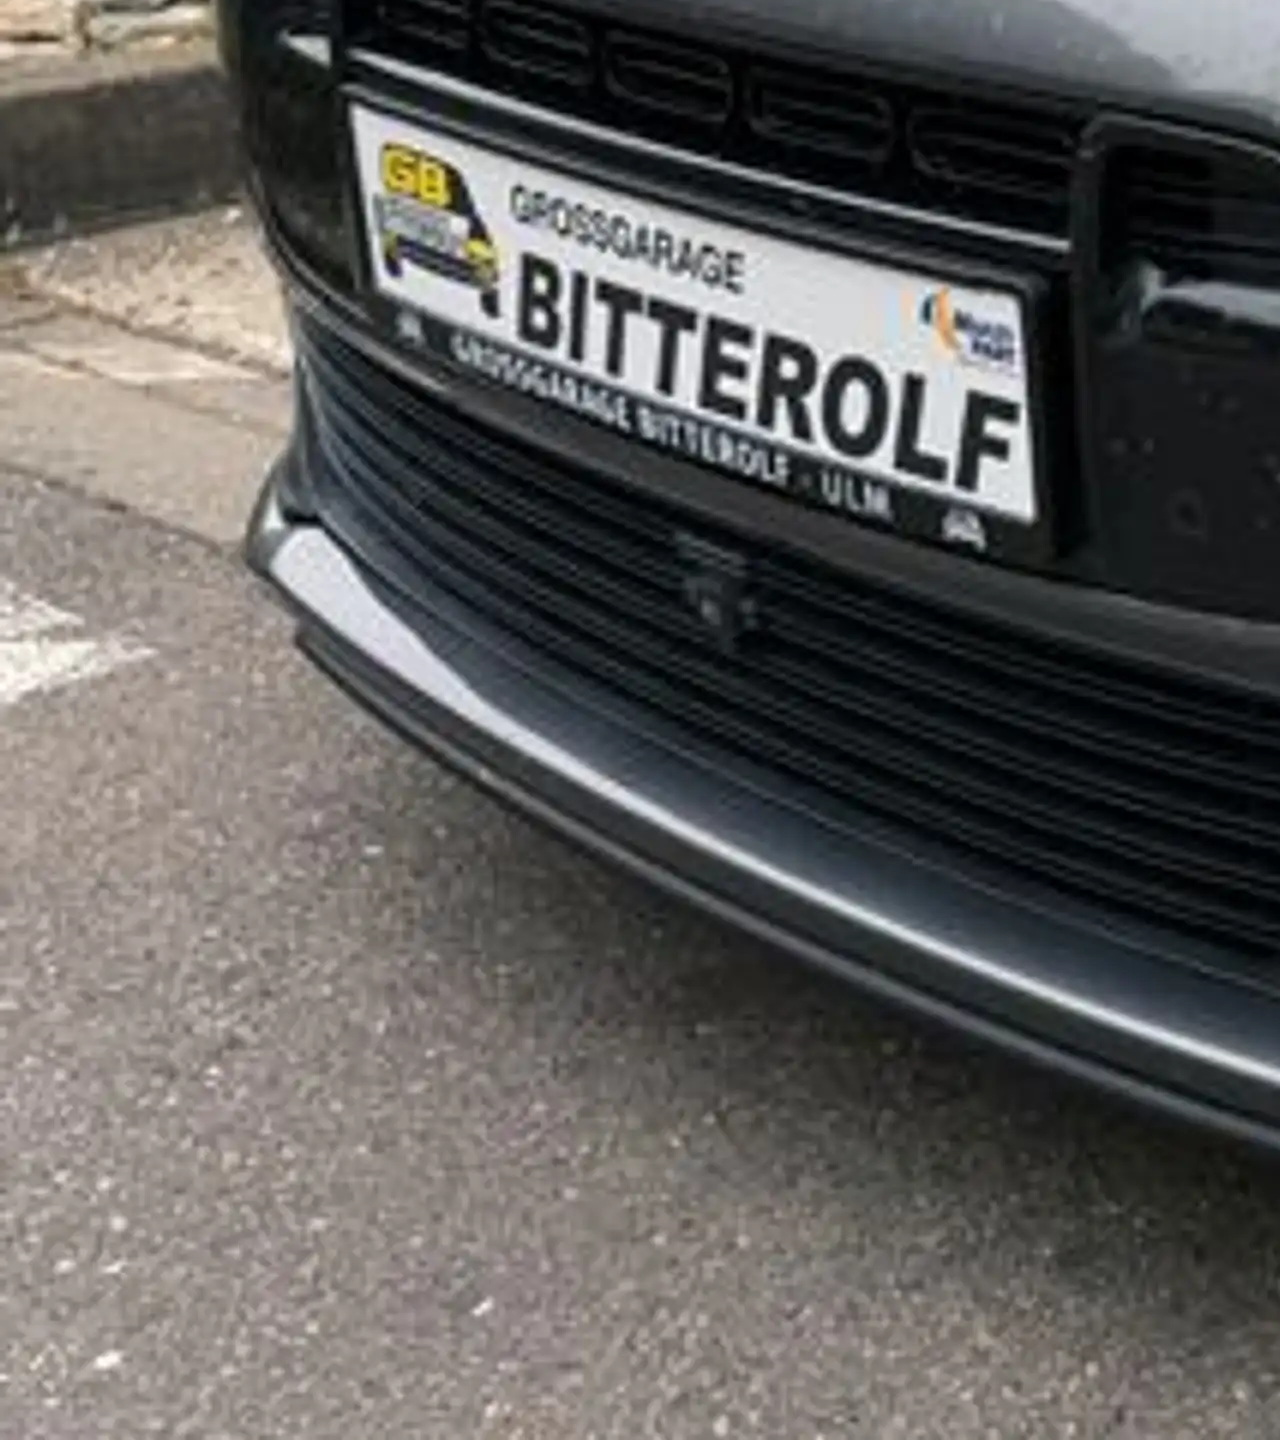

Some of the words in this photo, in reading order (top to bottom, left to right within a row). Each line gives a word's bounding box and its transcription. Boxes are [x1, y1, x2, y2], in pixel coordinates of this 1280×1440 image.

[383, 146, 452, 208] GB
[508, 183, 746, 294] GROSSGARAGE
[515, 251, 1022, 494] BITTEROLF
[820, 466, 899, 523] ULM
